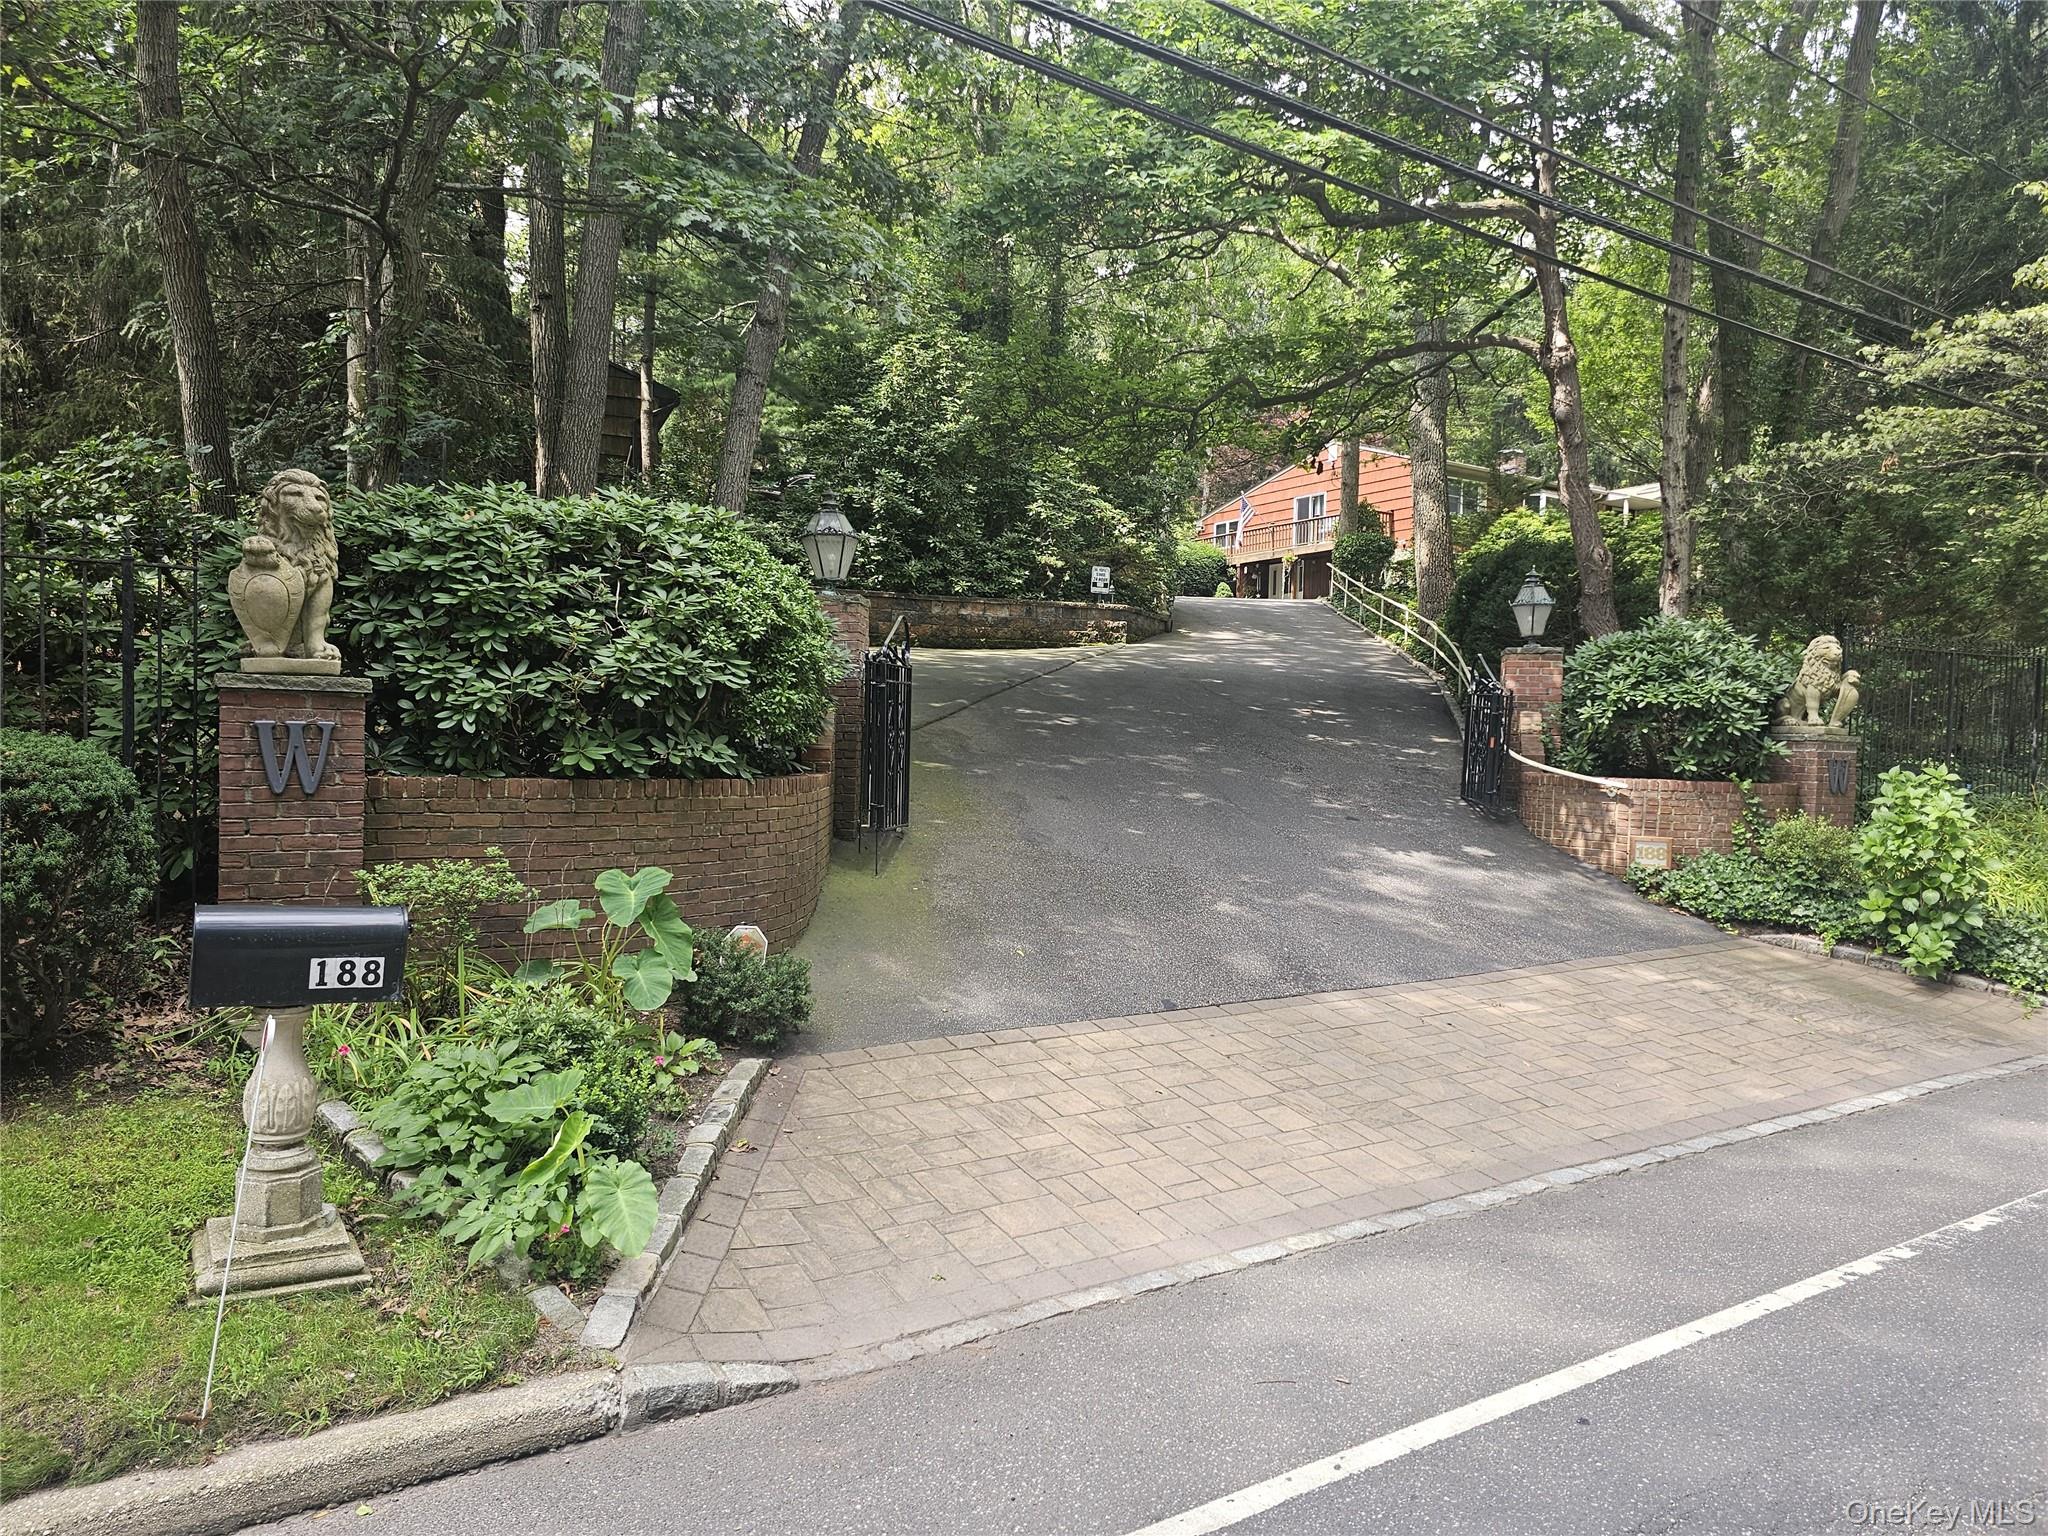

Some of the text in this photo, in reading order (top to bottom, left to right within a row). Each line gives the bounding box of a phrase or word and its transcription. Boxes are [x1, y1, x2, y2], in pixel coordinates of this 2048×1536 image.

[252, 719, 336, 795] W
[1827, 757, 1850, 796] W
[1635, 845, 1667, 861] 188
[314, 959, 382, 987] 188
